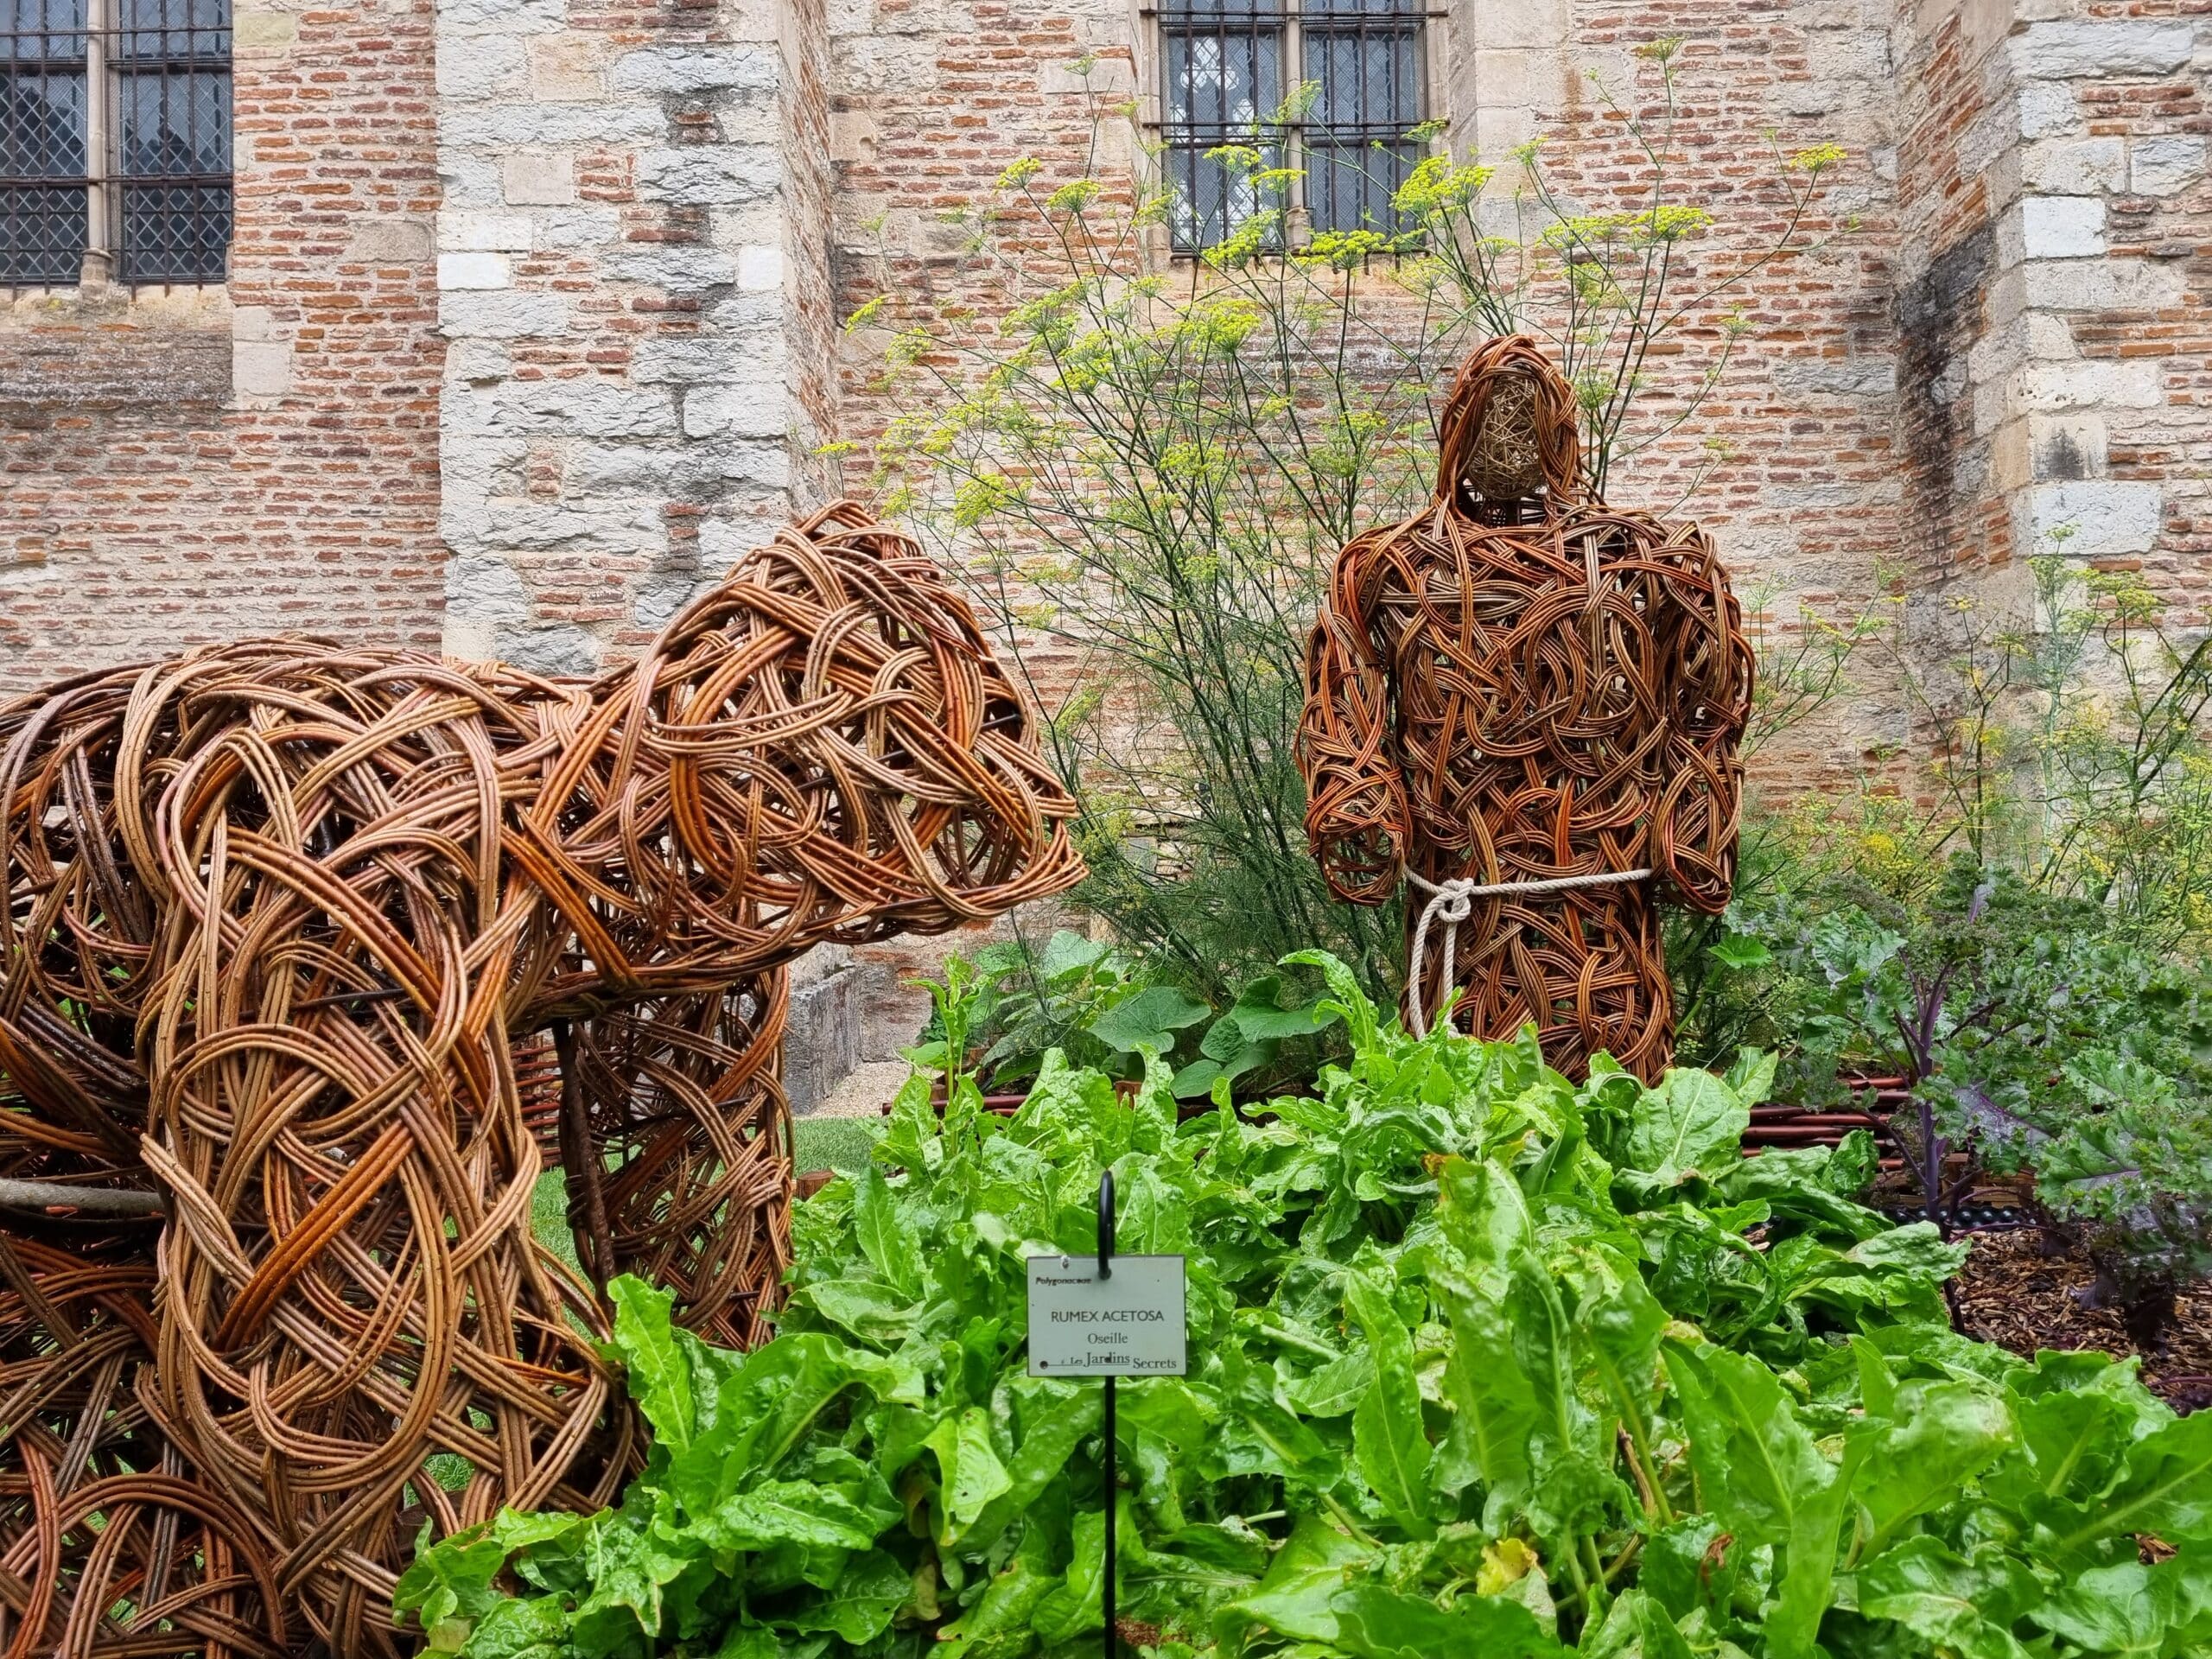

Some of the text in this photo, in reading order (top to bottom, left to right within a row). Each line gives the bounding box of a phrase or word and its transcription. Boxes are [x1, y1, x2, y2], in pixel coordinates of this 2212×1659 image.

[1035, 1276, 1092, 1286] Polygonaceae
[1051, 1310, 1164, 1322] RUMEX ACETOSA
[1087, 1332, 1128, 1344] Oseille
[1084, 1352, 1130, 1367] Jardins
[1133, 1357, 1177, 1369] Secrets
